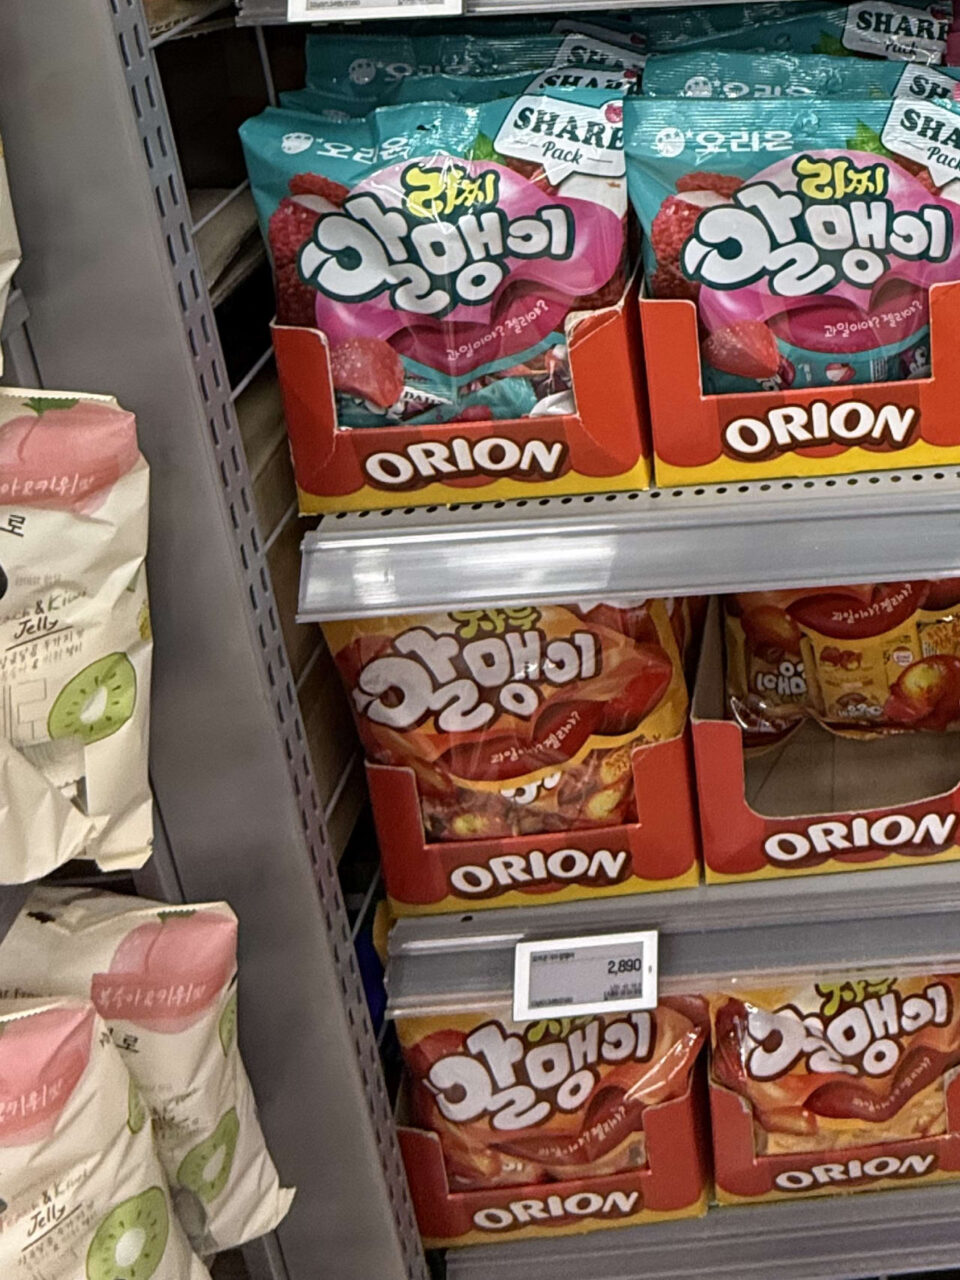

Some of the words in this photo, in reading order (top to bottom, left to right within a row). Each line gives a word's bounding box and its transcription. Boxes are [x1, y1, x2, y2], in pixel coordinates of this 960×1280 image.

[317, 136, 409, 164] 오리온
[512, 107, 625, 151] SHARE
[695, 130, 794, 154] 오리온
[541, 140, 584, 167] Pack
[301, 197, 568, 315] 알맹이
[684, 184, 946, 297] 알맹이
[446, 323, 505, 362] 과일이야?
[505, 300, 549, 336] 젤리야?
[823, 313, 881, 339] 과일이야?
[881, 300, 924, 329] 젤리야?
[725, 402, 916, 454] ORION
[366, 437, 564, 484] ORION
[14, 616, 59, 639] Jelly
[352, 628, 597, 733] 알맹이
[764, 813, 956, 861] ORION
[450, 849, 627, 893] ORION
[607, 957, 642, 976] 2,890
[421, 1012, 651, 1131] 알맹이
[775, 1154, 935, 1189] ORION
[27, 1204, 67, 1238] Jelly
[473, 1191, 639, 1230] ORION
